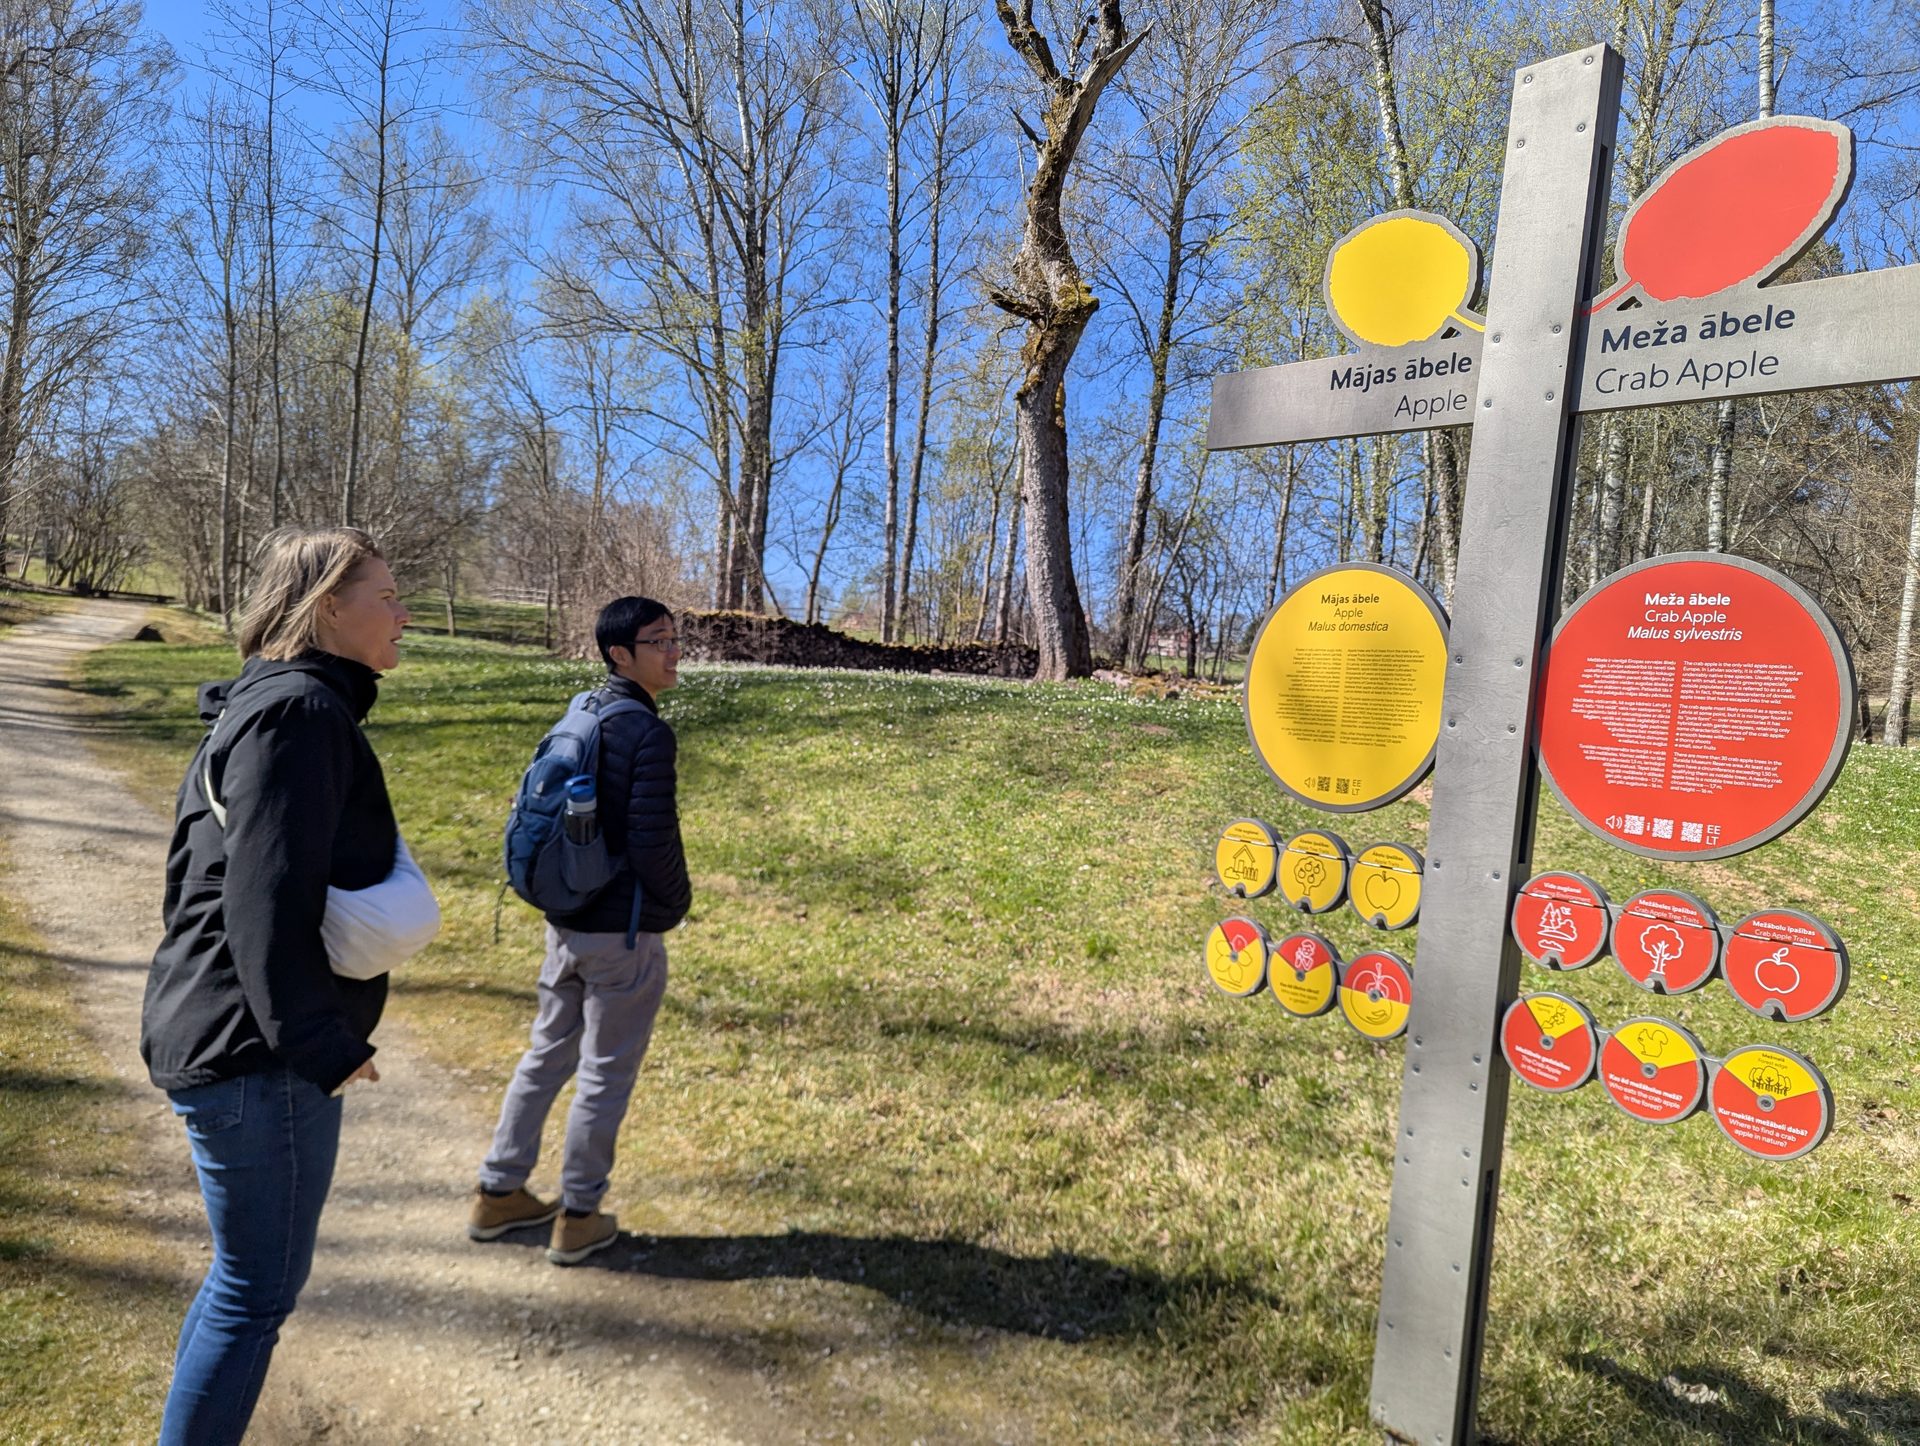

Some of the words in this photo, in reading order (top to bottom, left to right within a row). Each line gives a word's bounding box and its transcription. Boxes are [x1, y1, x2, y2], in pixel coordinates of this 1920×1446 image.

[1601, 320, 1687, 353] Meža
[1699, 304, 1795, 340] ābele
[1330, 364, 1397, 393] Mājas
[1405, 352, 1472, 381] ābele
[1596, 363, 1669, 394] Crab
[1676, 350, 1779, 390] Apple
[1394, 389, 1467, 422] Apple
[1321, 593, 1350, 606] Mājas
[1352, 594, 1380, 604] ābele
[1645, 592, 1685, 605] Meža
[1689, 592, 1731, 605] ābele
[1334, 608, 1363, 620] Apple
[1645, 609, 1679, 622] Crab
[1681, 610, 1727, 626] Apple
[1308, 621, 1336, 631] Malus
[1339, 621, 1389, 631] domestica
[1627, 626, 1670, 639] Malus
[1673, 627, 1743, 643] sylvestris
[1352, 779, 1362, 787] EE
[1707, 825, 1721, 835] EE
[1706, 836, 1719, 845] LT
[1729, 1118, 1751, 1129] Where
[1761, 1126, 1774, 1136] find
[1780, 1133, 1796, 1142] crab
[1734, 1129, 1753, 1139] apple
[1754, 1133, 1760, 1141] in
[1762, 1136, 1787, 1147] nature?
